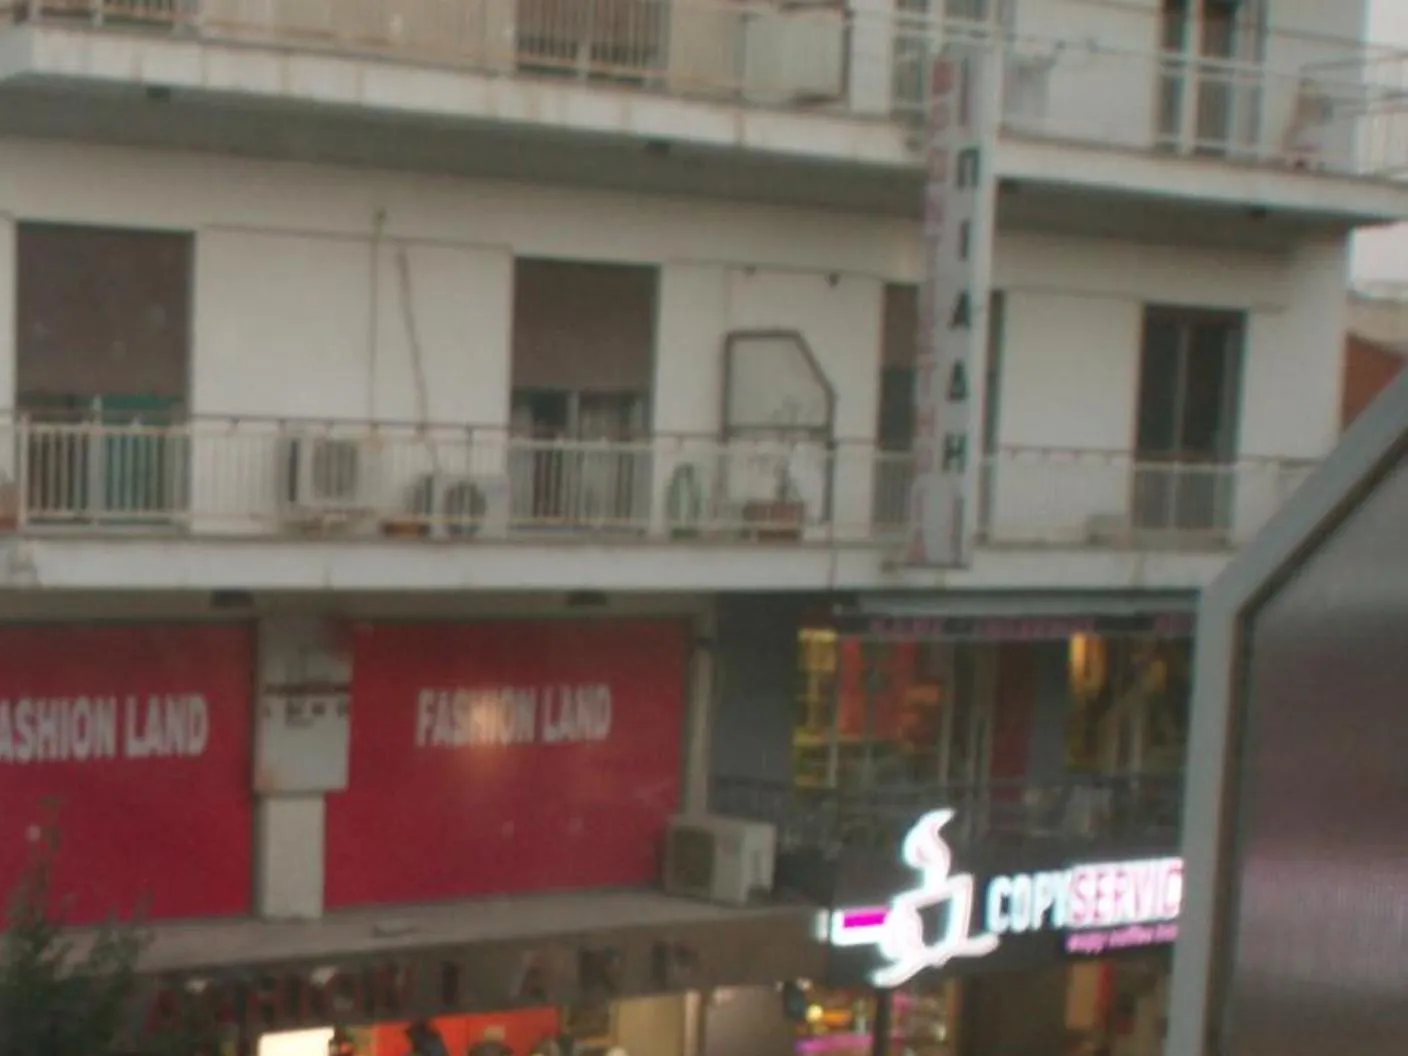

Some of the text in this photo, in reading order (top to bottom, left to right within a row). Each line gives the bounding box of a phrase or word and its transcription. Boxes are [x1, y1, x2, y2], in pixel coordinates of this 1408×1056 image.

[123, 691, 208, 758] LAND
[415, 681, 612, 747] FASHION LAND
[985, 857, 1185, 934] COPYSERVIC
